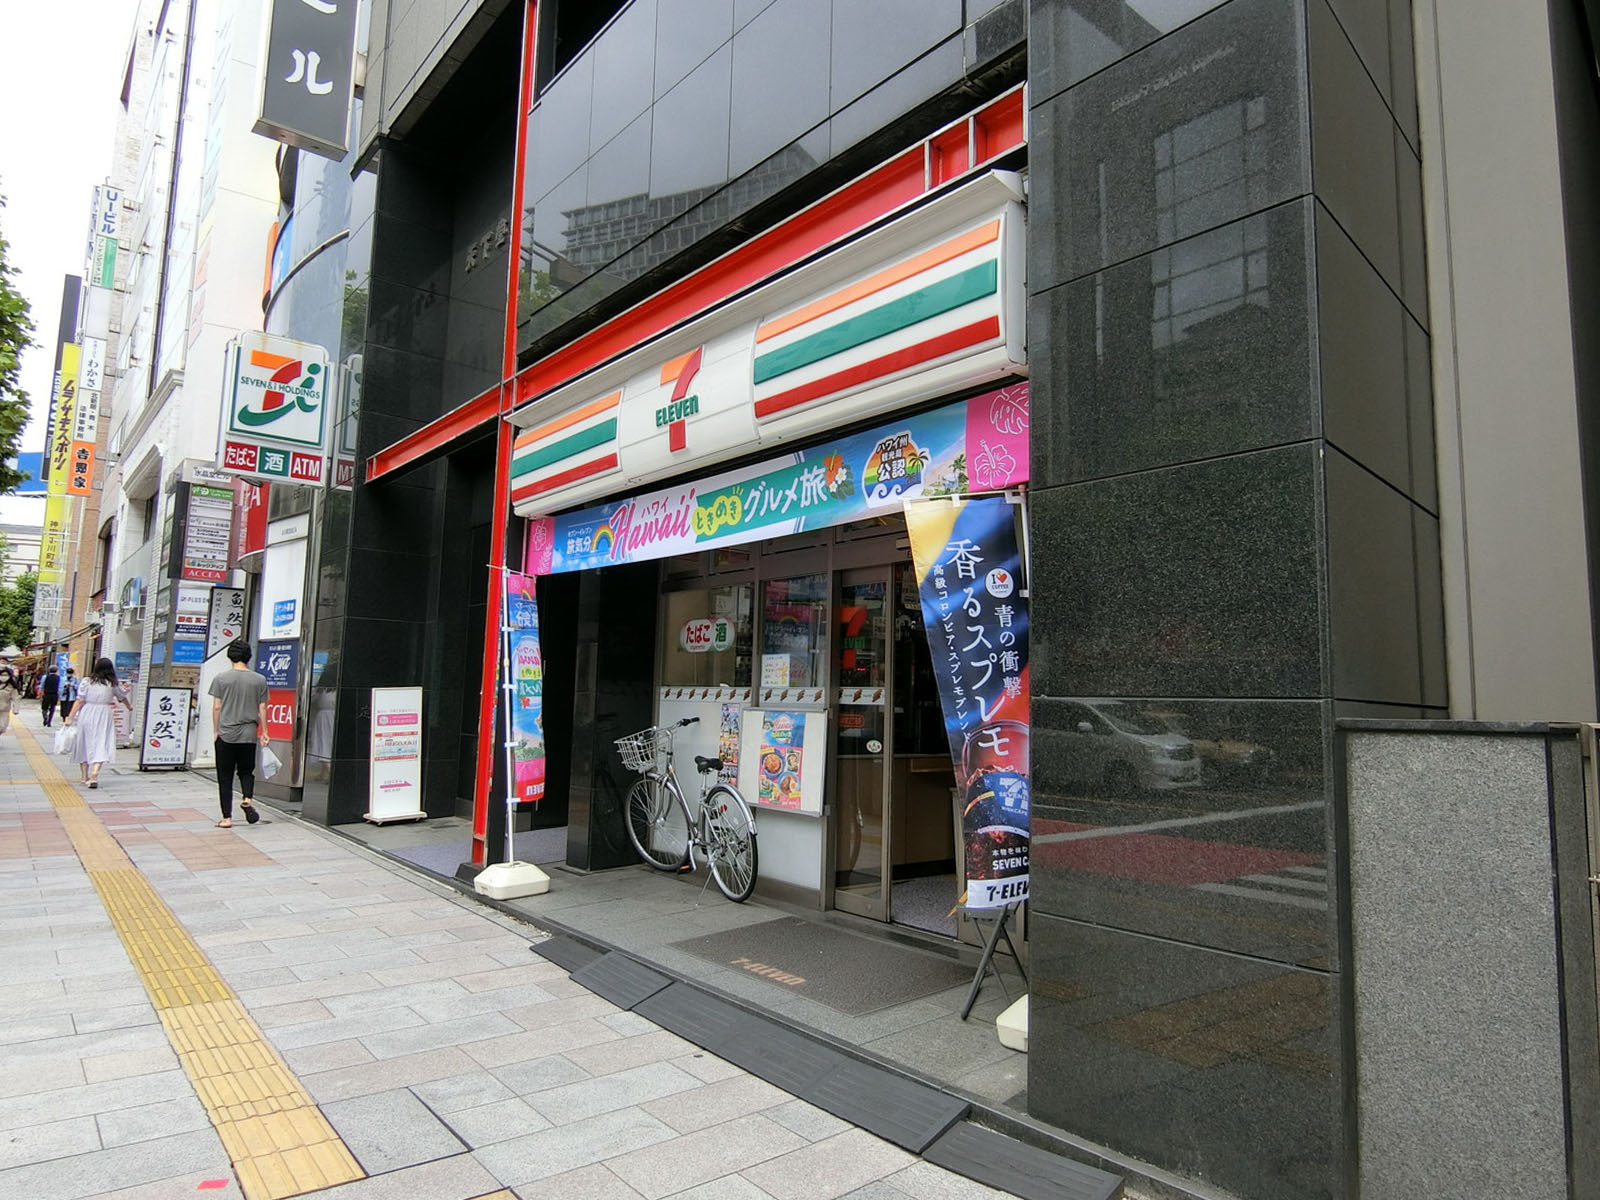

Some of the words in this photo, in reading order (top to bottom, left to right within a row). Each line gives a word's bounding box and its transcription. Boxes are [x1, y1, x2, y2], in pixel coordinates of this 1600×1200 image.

[278, 383, 320, 399] HOLDINGS
[876, 433, 909, 454] ハワイ州
[225, 446, 256, 467] たばこ
[264, 452, 285, 472] 酒
[292, 457, 320, 478] ATM
[877, 458, 906, 482] 公認
[641, 496, 669, 518] ハワイ
[609, 487, 696, 560] Hawaii
[686, 623, 711, 643] たばこ
[714, 623, 727, 642] 酒
[945, 538, 1010, 756] 香るスプレモ
[994, 604, 1022, 699] 青の衝撃
[992, 857, 1022, 871] SEVEN
